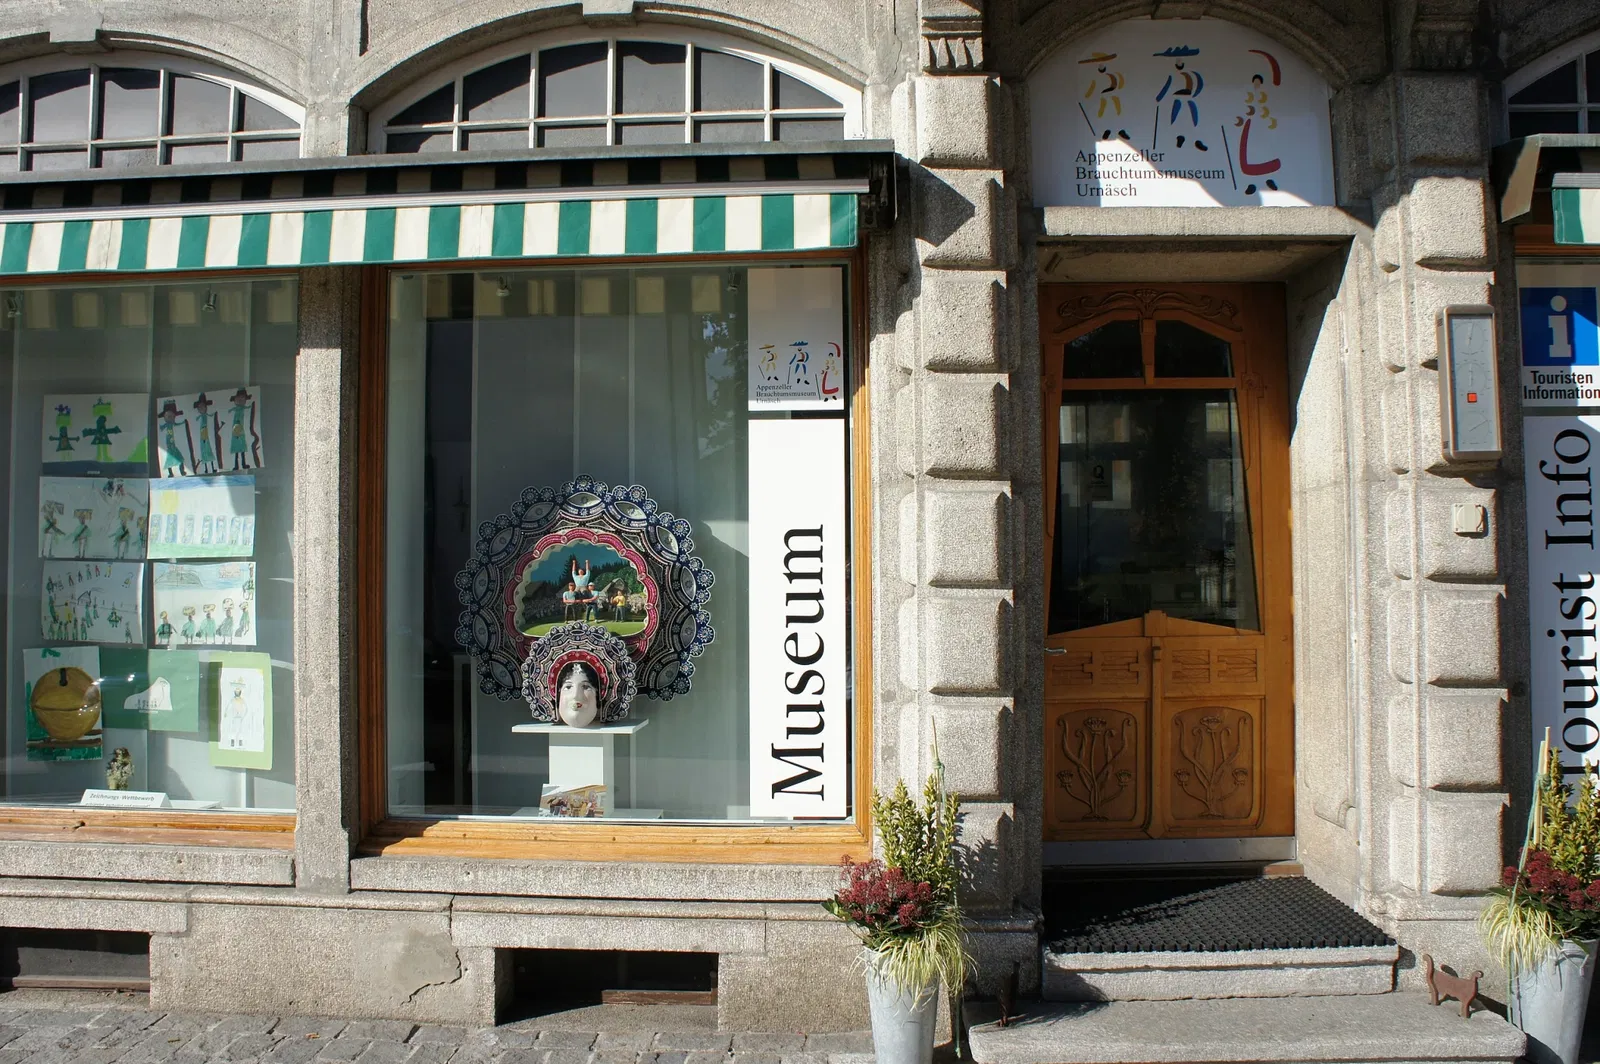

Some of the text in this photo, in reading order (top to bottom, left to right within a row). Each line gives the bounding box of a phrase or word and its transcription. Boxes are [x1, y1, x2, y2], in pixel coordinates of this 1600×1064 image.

[1075, 149, 1165, 165] Appenzeller
[1075, 166, 1225, 180] Brauchtumsmuseum
[1076, 183, 1138, 197] Urnäsch
[1530, 370, 1593, 385] Touristen
[1523, 385, 1600, 400] Information
[1538, 429, 1594, 551] Info
[771, 524, 826, 801] Museum
